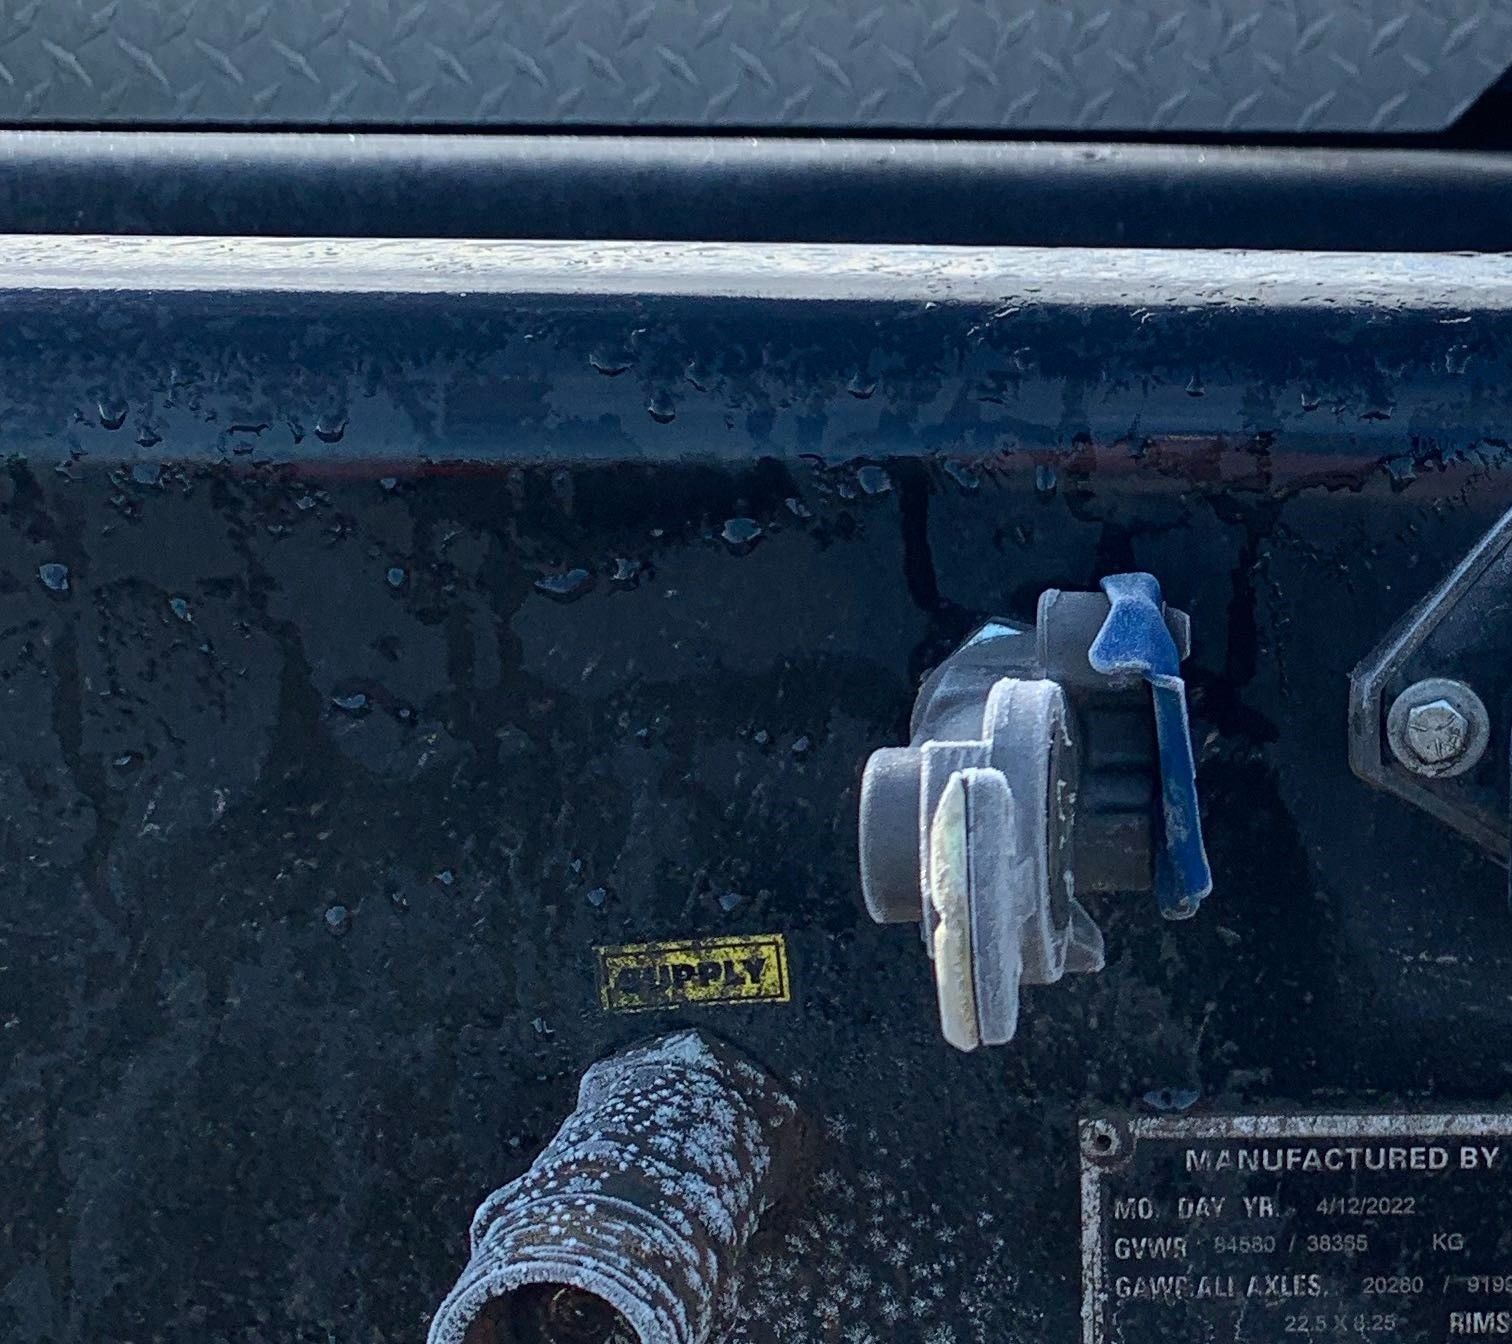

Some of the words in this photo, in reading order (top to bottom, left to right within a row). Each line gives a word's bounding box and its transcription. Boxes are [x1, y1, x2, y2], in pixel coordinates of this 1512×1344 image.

[1186, 1147, 1449, 1171] MANUFACTURED
[1460, 1147, 1500, 1170] BY
[1177, 1197, 1224, 1219] DAY
[1316, 1197, 1416, 1216] 4/12/2022
[1114, 1237, 1188, 1260] GVWR
[1432, 1233, 1465, 1251] KG
[1285, 1313, 1328, 1334] 22.5
